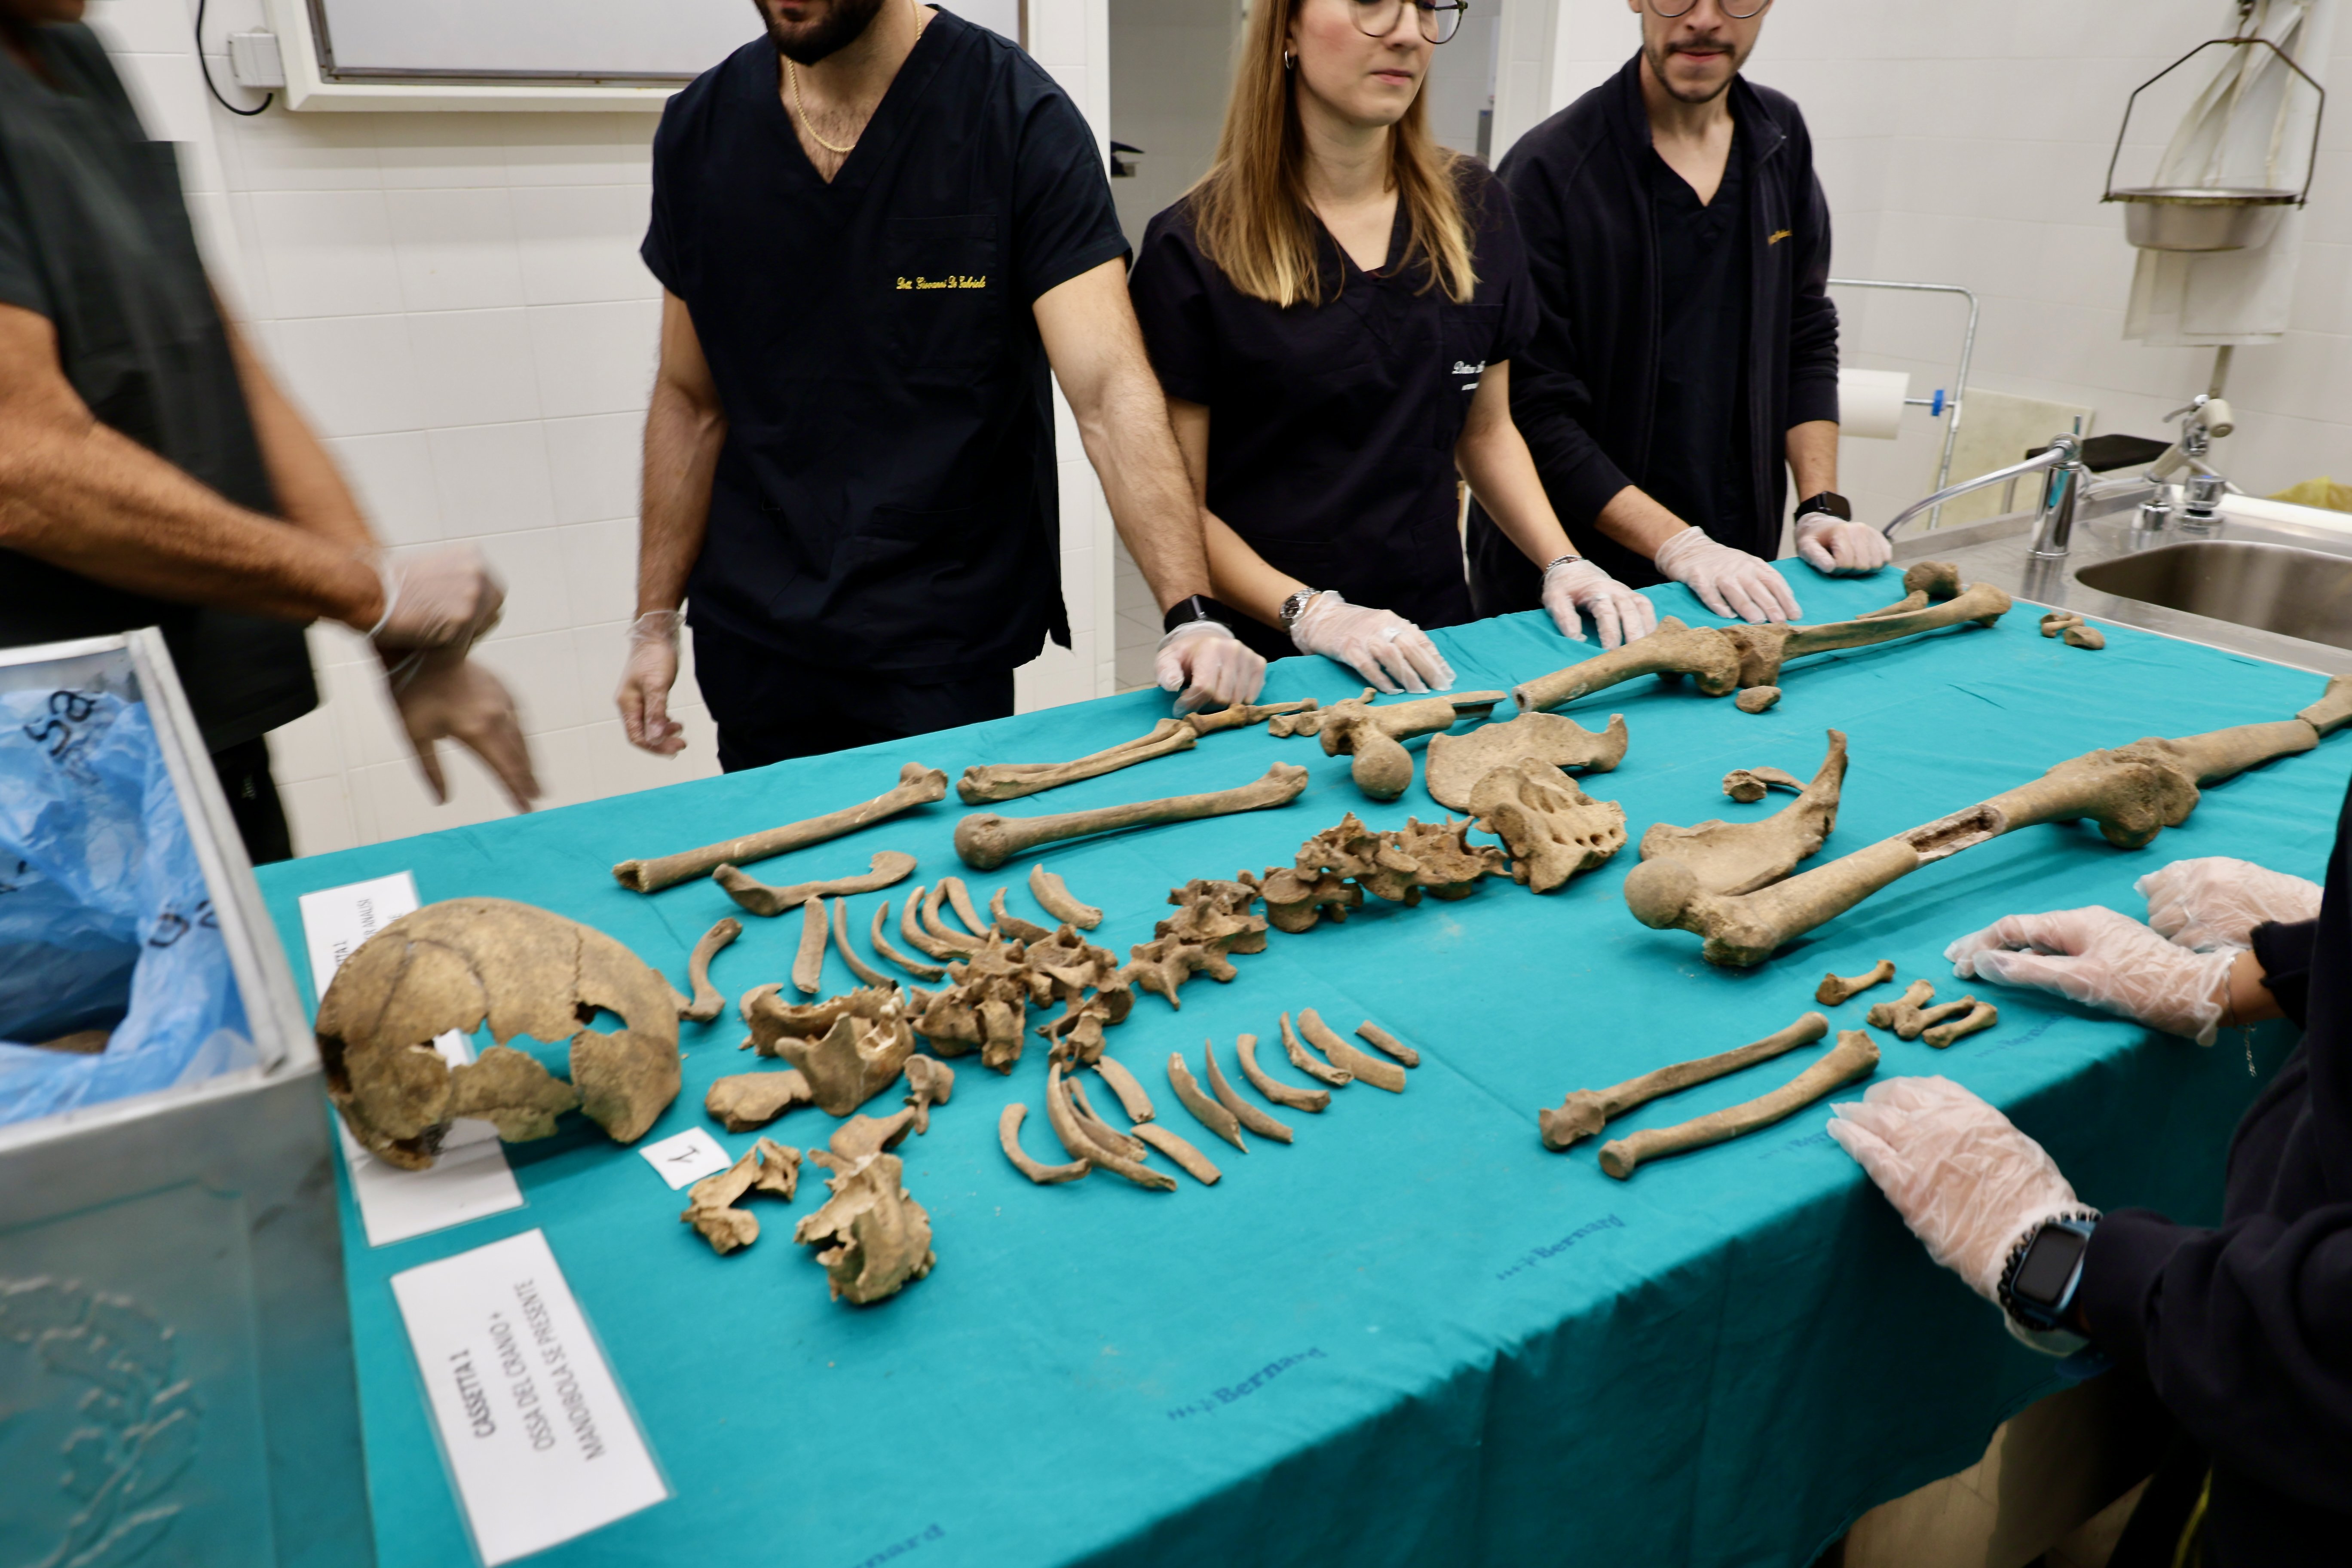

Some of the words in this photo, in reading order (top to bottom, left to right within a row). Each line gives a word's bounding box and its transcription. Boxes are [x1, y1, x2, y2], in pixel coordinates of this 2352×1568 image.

[357, 898, 376, 928] ANALISI
[514, 1278, 557, 1346] PRESENTE
[449, 1349, 470, 1362] 1
[489, 1322, 527, 1377] CRANIO
[541, 1344, 566, 1365] SE
[454, 1360, 496, 1438] CASSETTA
[512, 1376, 539, 1408] DEL
[551, 1363, 605, 1461] MANDIBOLA
[523, 1406, 555, 1452] OSSA
